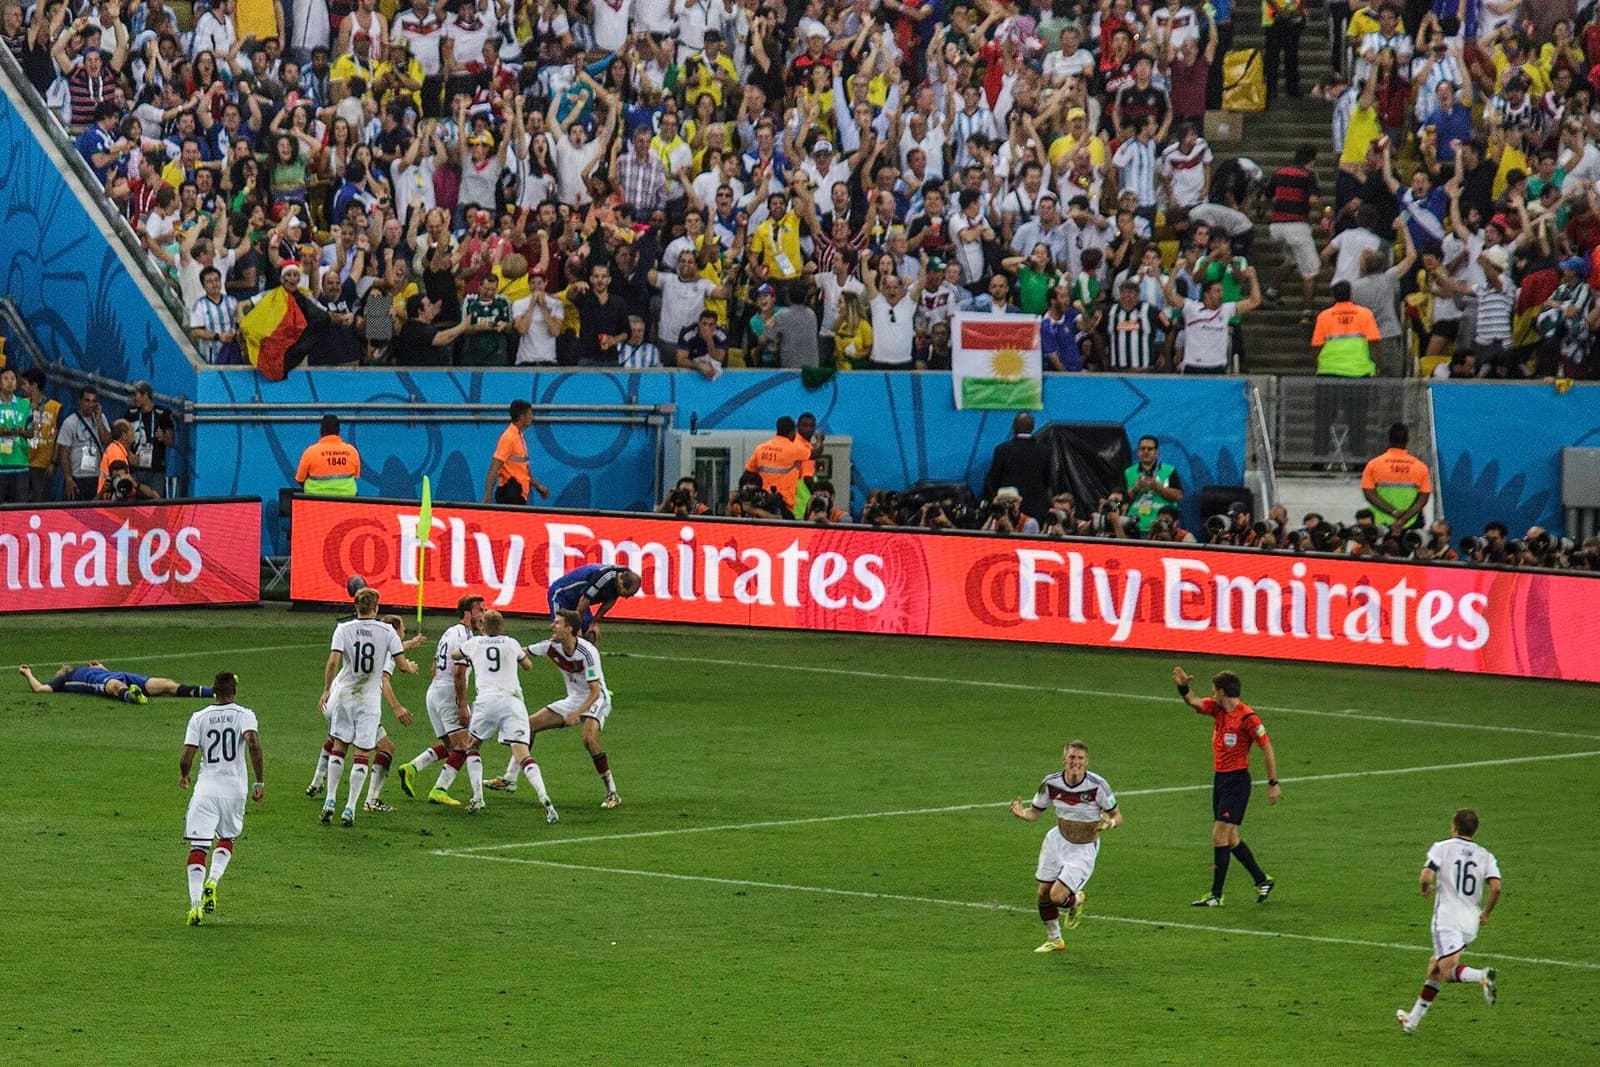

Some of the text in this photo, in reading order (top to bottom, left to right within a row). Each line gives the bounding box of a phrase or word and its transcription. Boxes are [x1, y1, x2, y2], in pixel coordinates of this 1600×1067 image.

[327, 457, 347, 466] 1840
[397, 514, 886, 611] Fly Emirates
[1015, 548, 1491, 650] Fly Emirates
[353, 641, 375, 673] 18
[486, 646, 500, 672] 9
[206, 727, 236, 763] 20
[1454, 859, 1478, 896] 16
